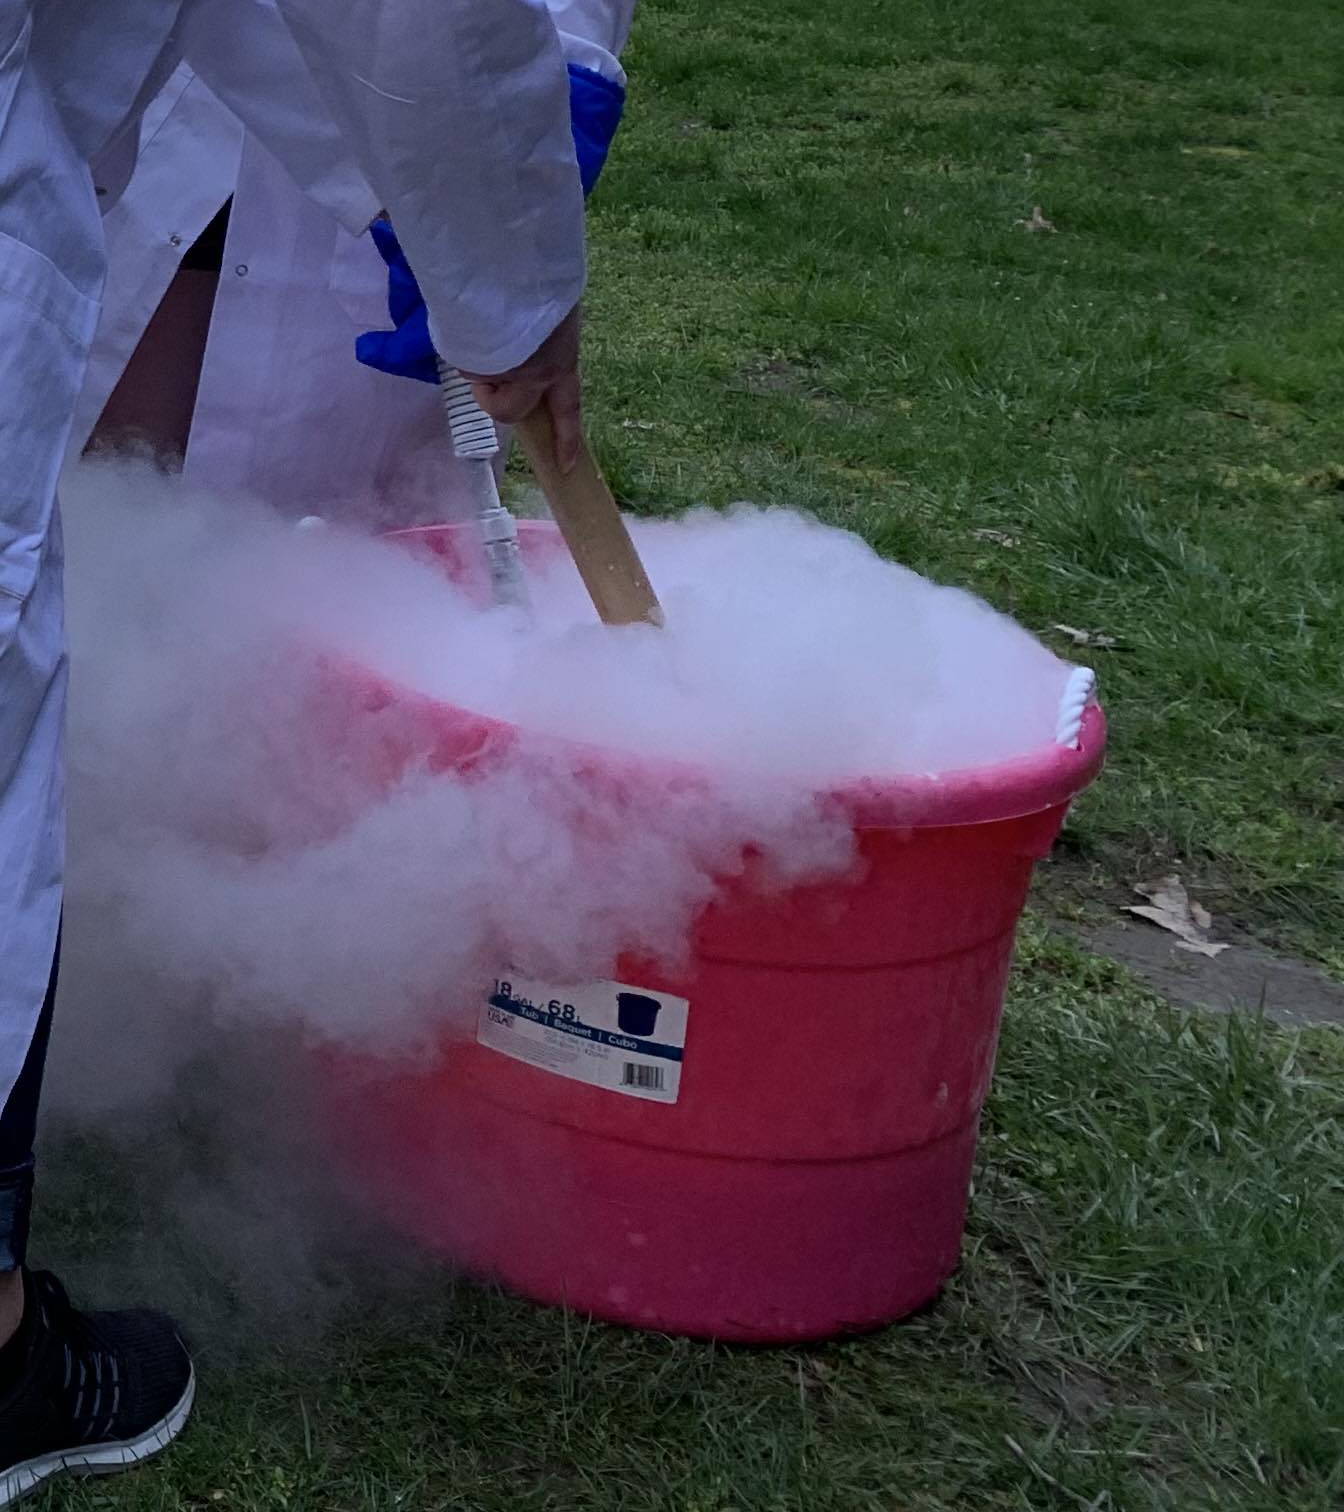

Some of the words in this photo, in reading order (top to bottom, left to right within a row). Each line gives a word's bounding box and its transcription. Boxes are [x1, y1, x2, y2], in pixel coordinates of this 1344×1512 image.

[548, 999, 575, 1021] 68
[520, 1006, 539, 1020] Tub
[608, 1035, 638, 1050] Cubo
